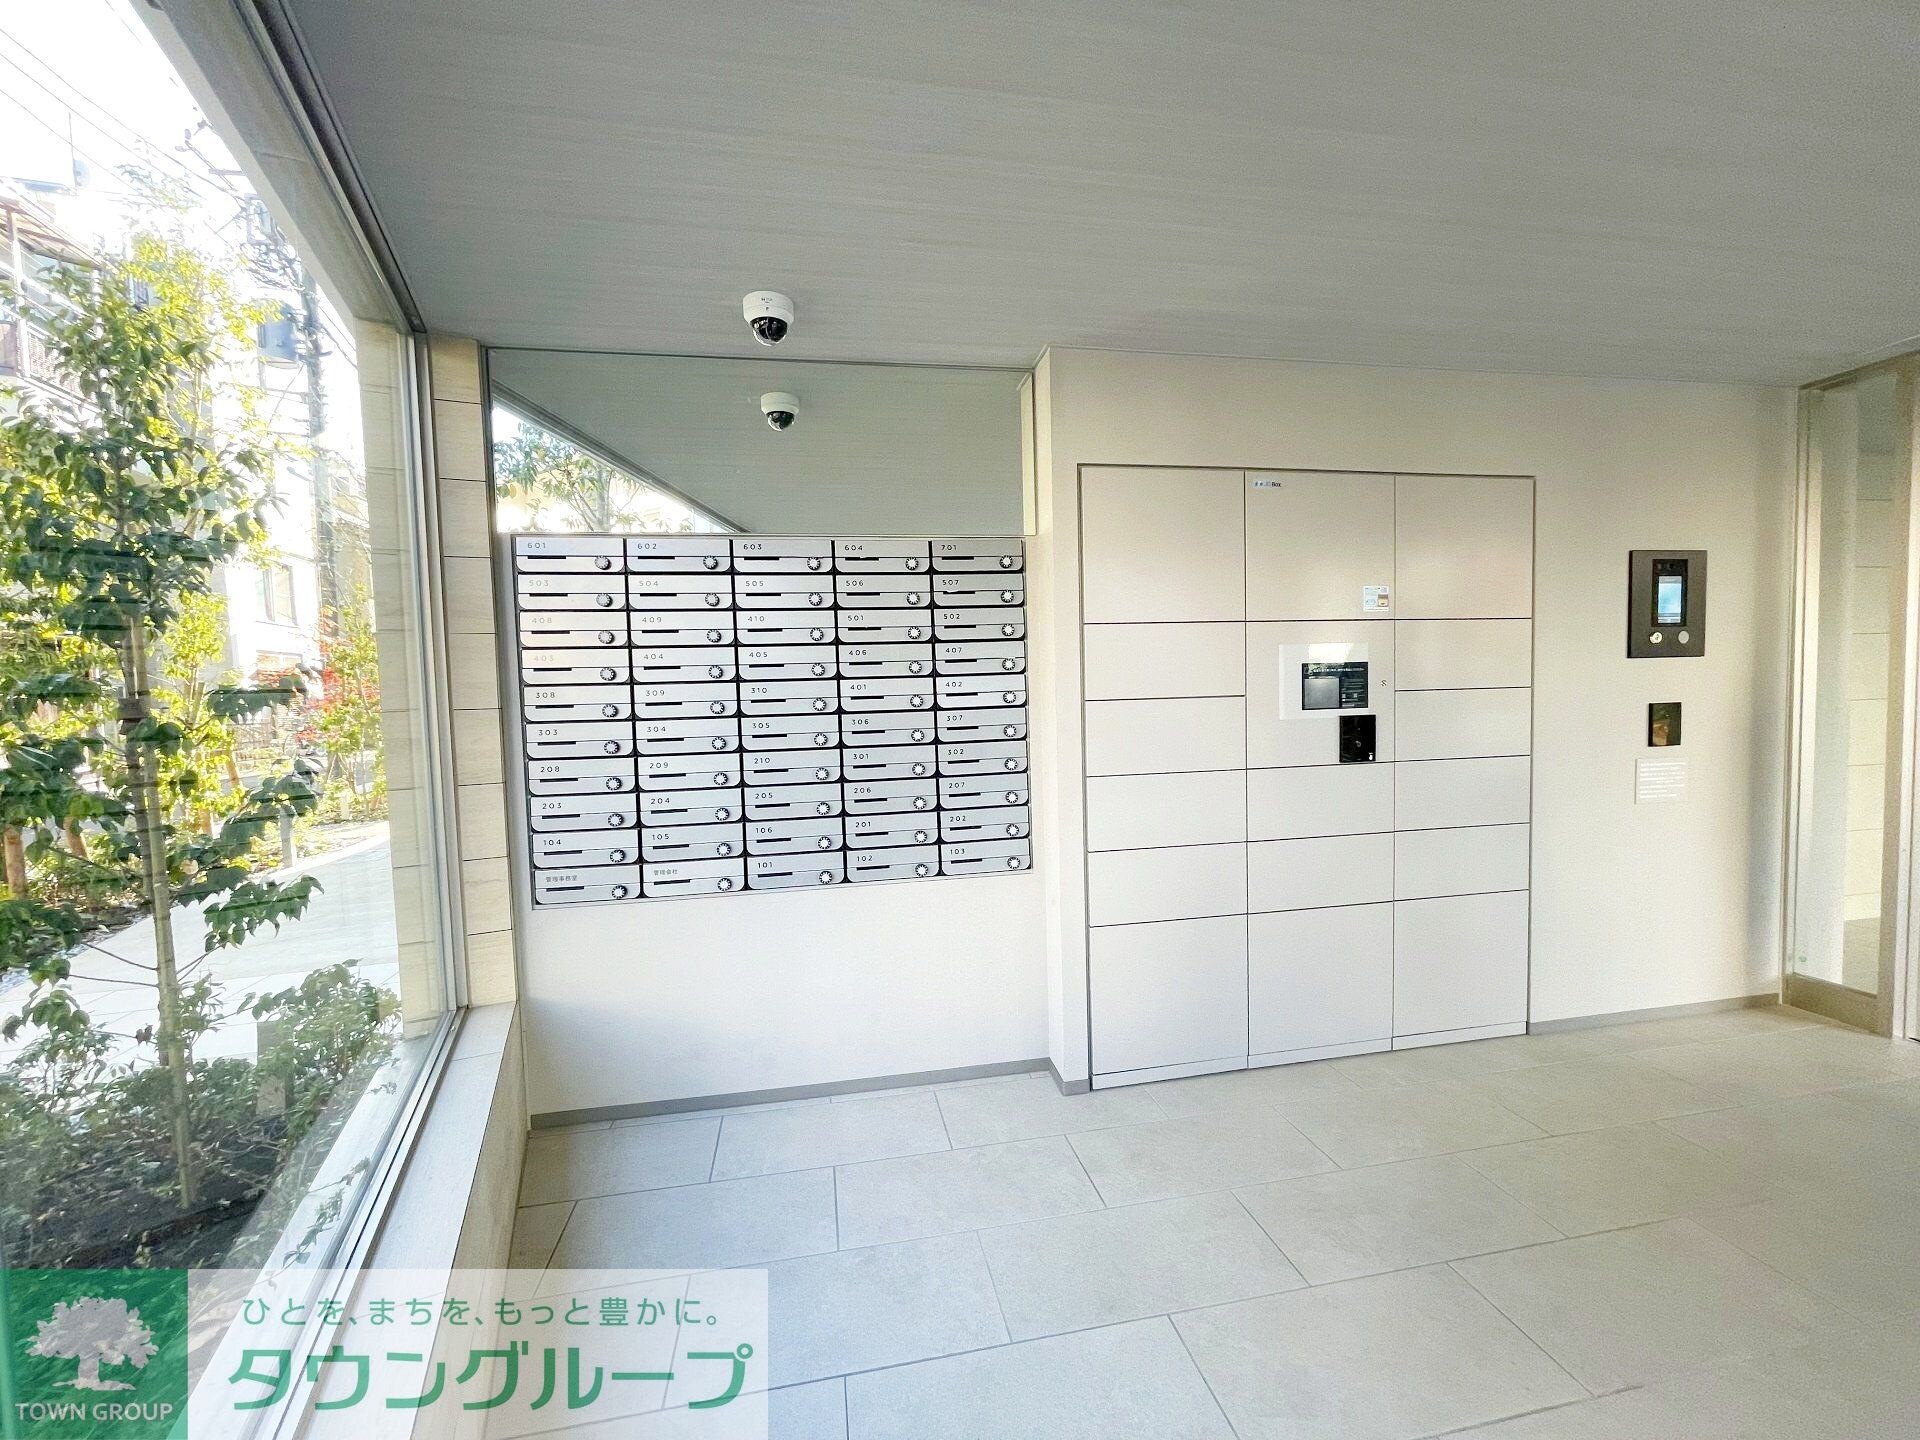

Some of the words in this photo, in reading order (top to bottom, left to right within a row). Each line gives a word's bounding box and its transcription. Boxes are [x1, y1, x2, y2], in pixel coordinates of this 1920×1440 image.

[637, 542, 657, 550] 602
[743, 543, 762, 551] 603
[846, 579, 864, 587] 506
[642, 616, 662, 624] 409
[748, 615, 765, 623] 410
[847, 614, 863, 622] 501
[945, 646, 962, 654] 407
[850, 683, 866, 691] 401
[536, 691, 555, 699] 308
[646, 689, 664, 697] 309
[852, 718, 869, 726] 306
[947, 714, 963, 722] 307
[538, 729, 558, 737] 303
[948, 748, 964, 756] 302
[650, 761, 668, 769] 209
[754, 757, 770, 765] 210
[540, 765, 559, 773] 208
[949, 781, 965, 789] 207
[854, 786, 872, 794] 206
[755, 792, 773, 800] 205
[651, 797, 670, 805] 204
[542, 802, 562, 810] 203
[950, 815, 966, 823] 202
[756, 826, 773, 834] 106
[652, 833, 669, 841] 105
[857, 854, 872, 862] 102
[758, 861, 773, 869] 101
